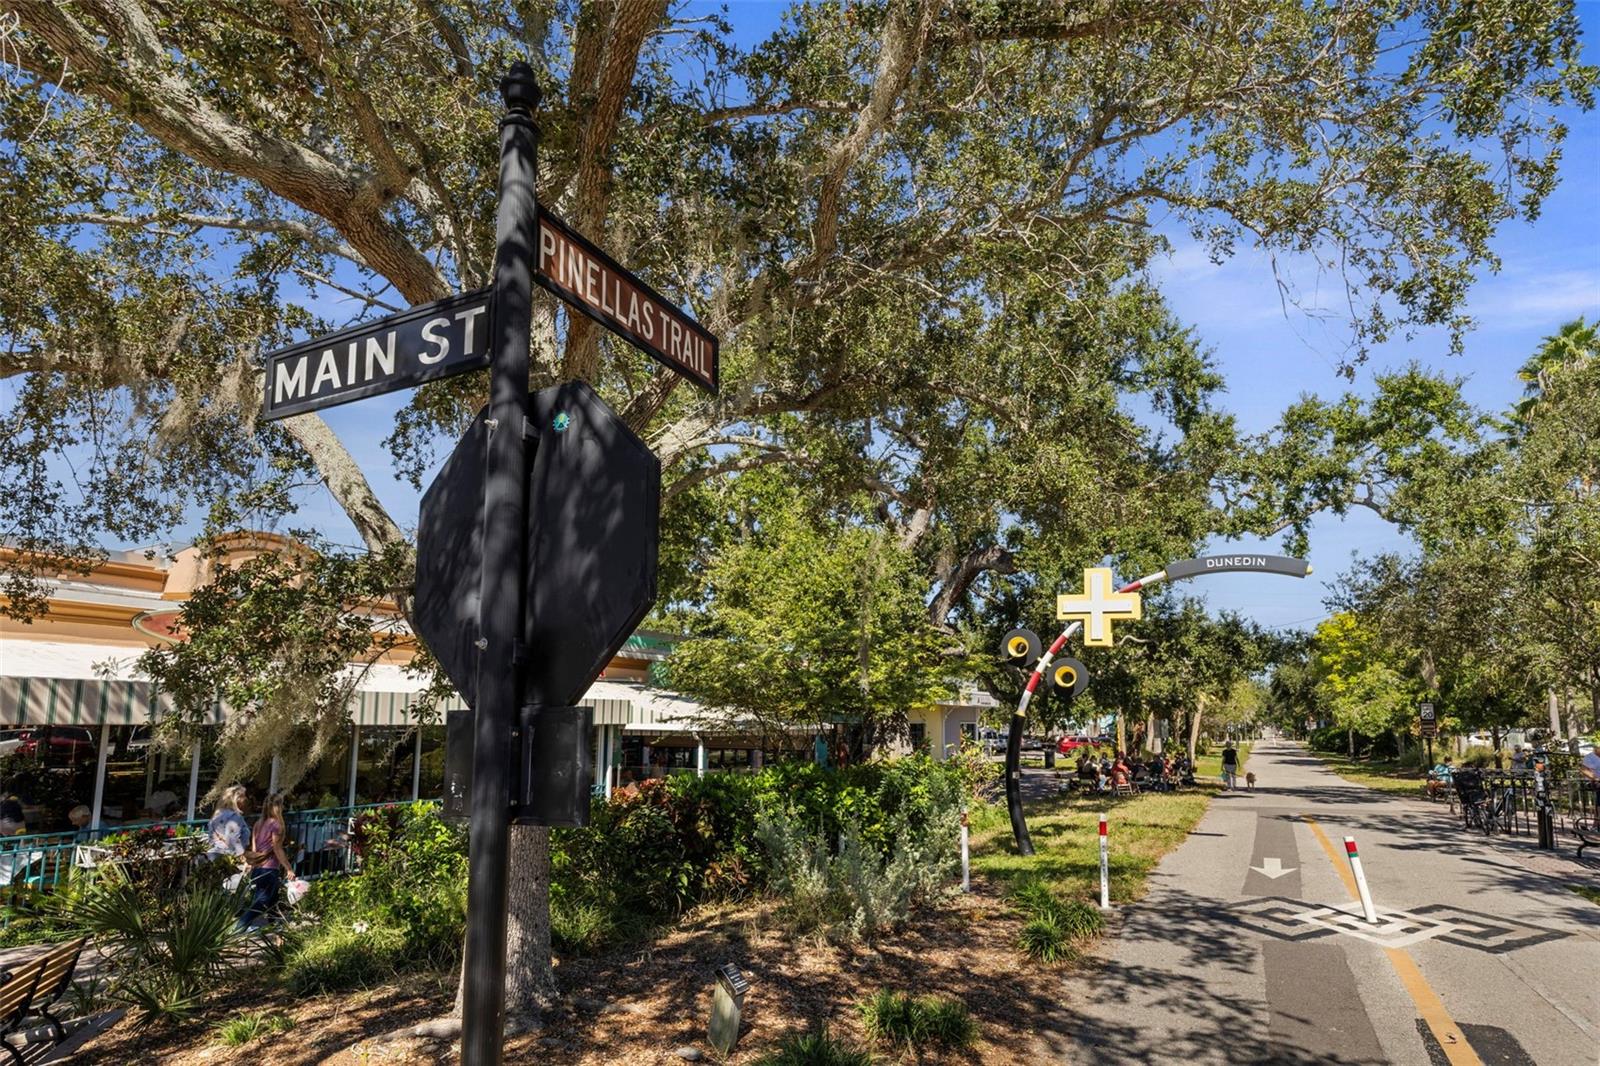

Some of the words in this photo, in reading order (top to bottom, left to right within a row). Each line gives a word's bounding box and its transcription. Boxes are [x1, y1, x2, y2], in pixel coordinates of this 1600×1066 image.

[540, 225, 654, 340] PINELLAS
[660, 311, 710, 378] TRAIL
[274, 331, 397, 404] MAIN
[418, 305, 486, 365] ST
[1206, 557, 1266, 568] DUNEDIN
[1423, 711, 1433, 719] 20
